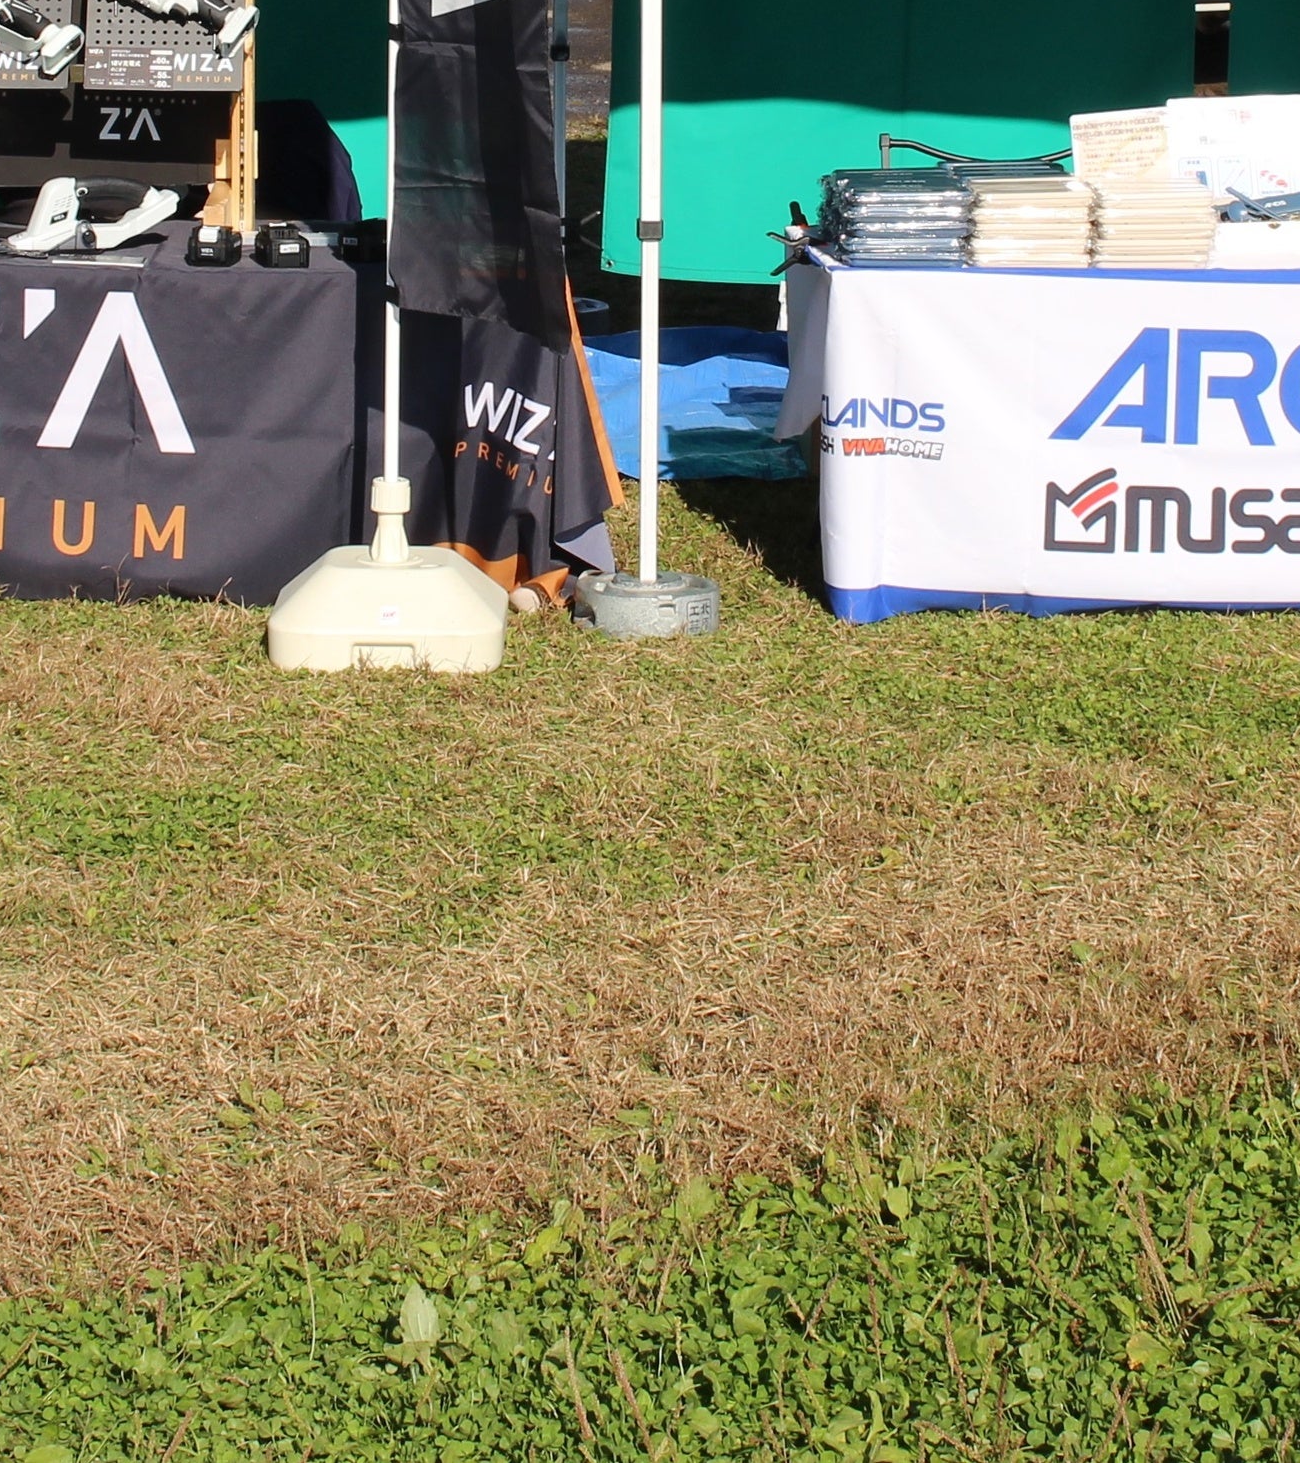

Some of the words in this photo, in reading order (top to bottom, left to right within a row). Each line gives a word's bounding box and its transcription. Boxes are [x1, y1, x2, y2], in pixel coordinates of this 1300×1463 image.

[177, 75, 232, 83] REMIUM
[464, 381, 557, 461] WIZ
[821, 394, 946, 433] LANDS
[454, 441, 553, 495] PREMIU
